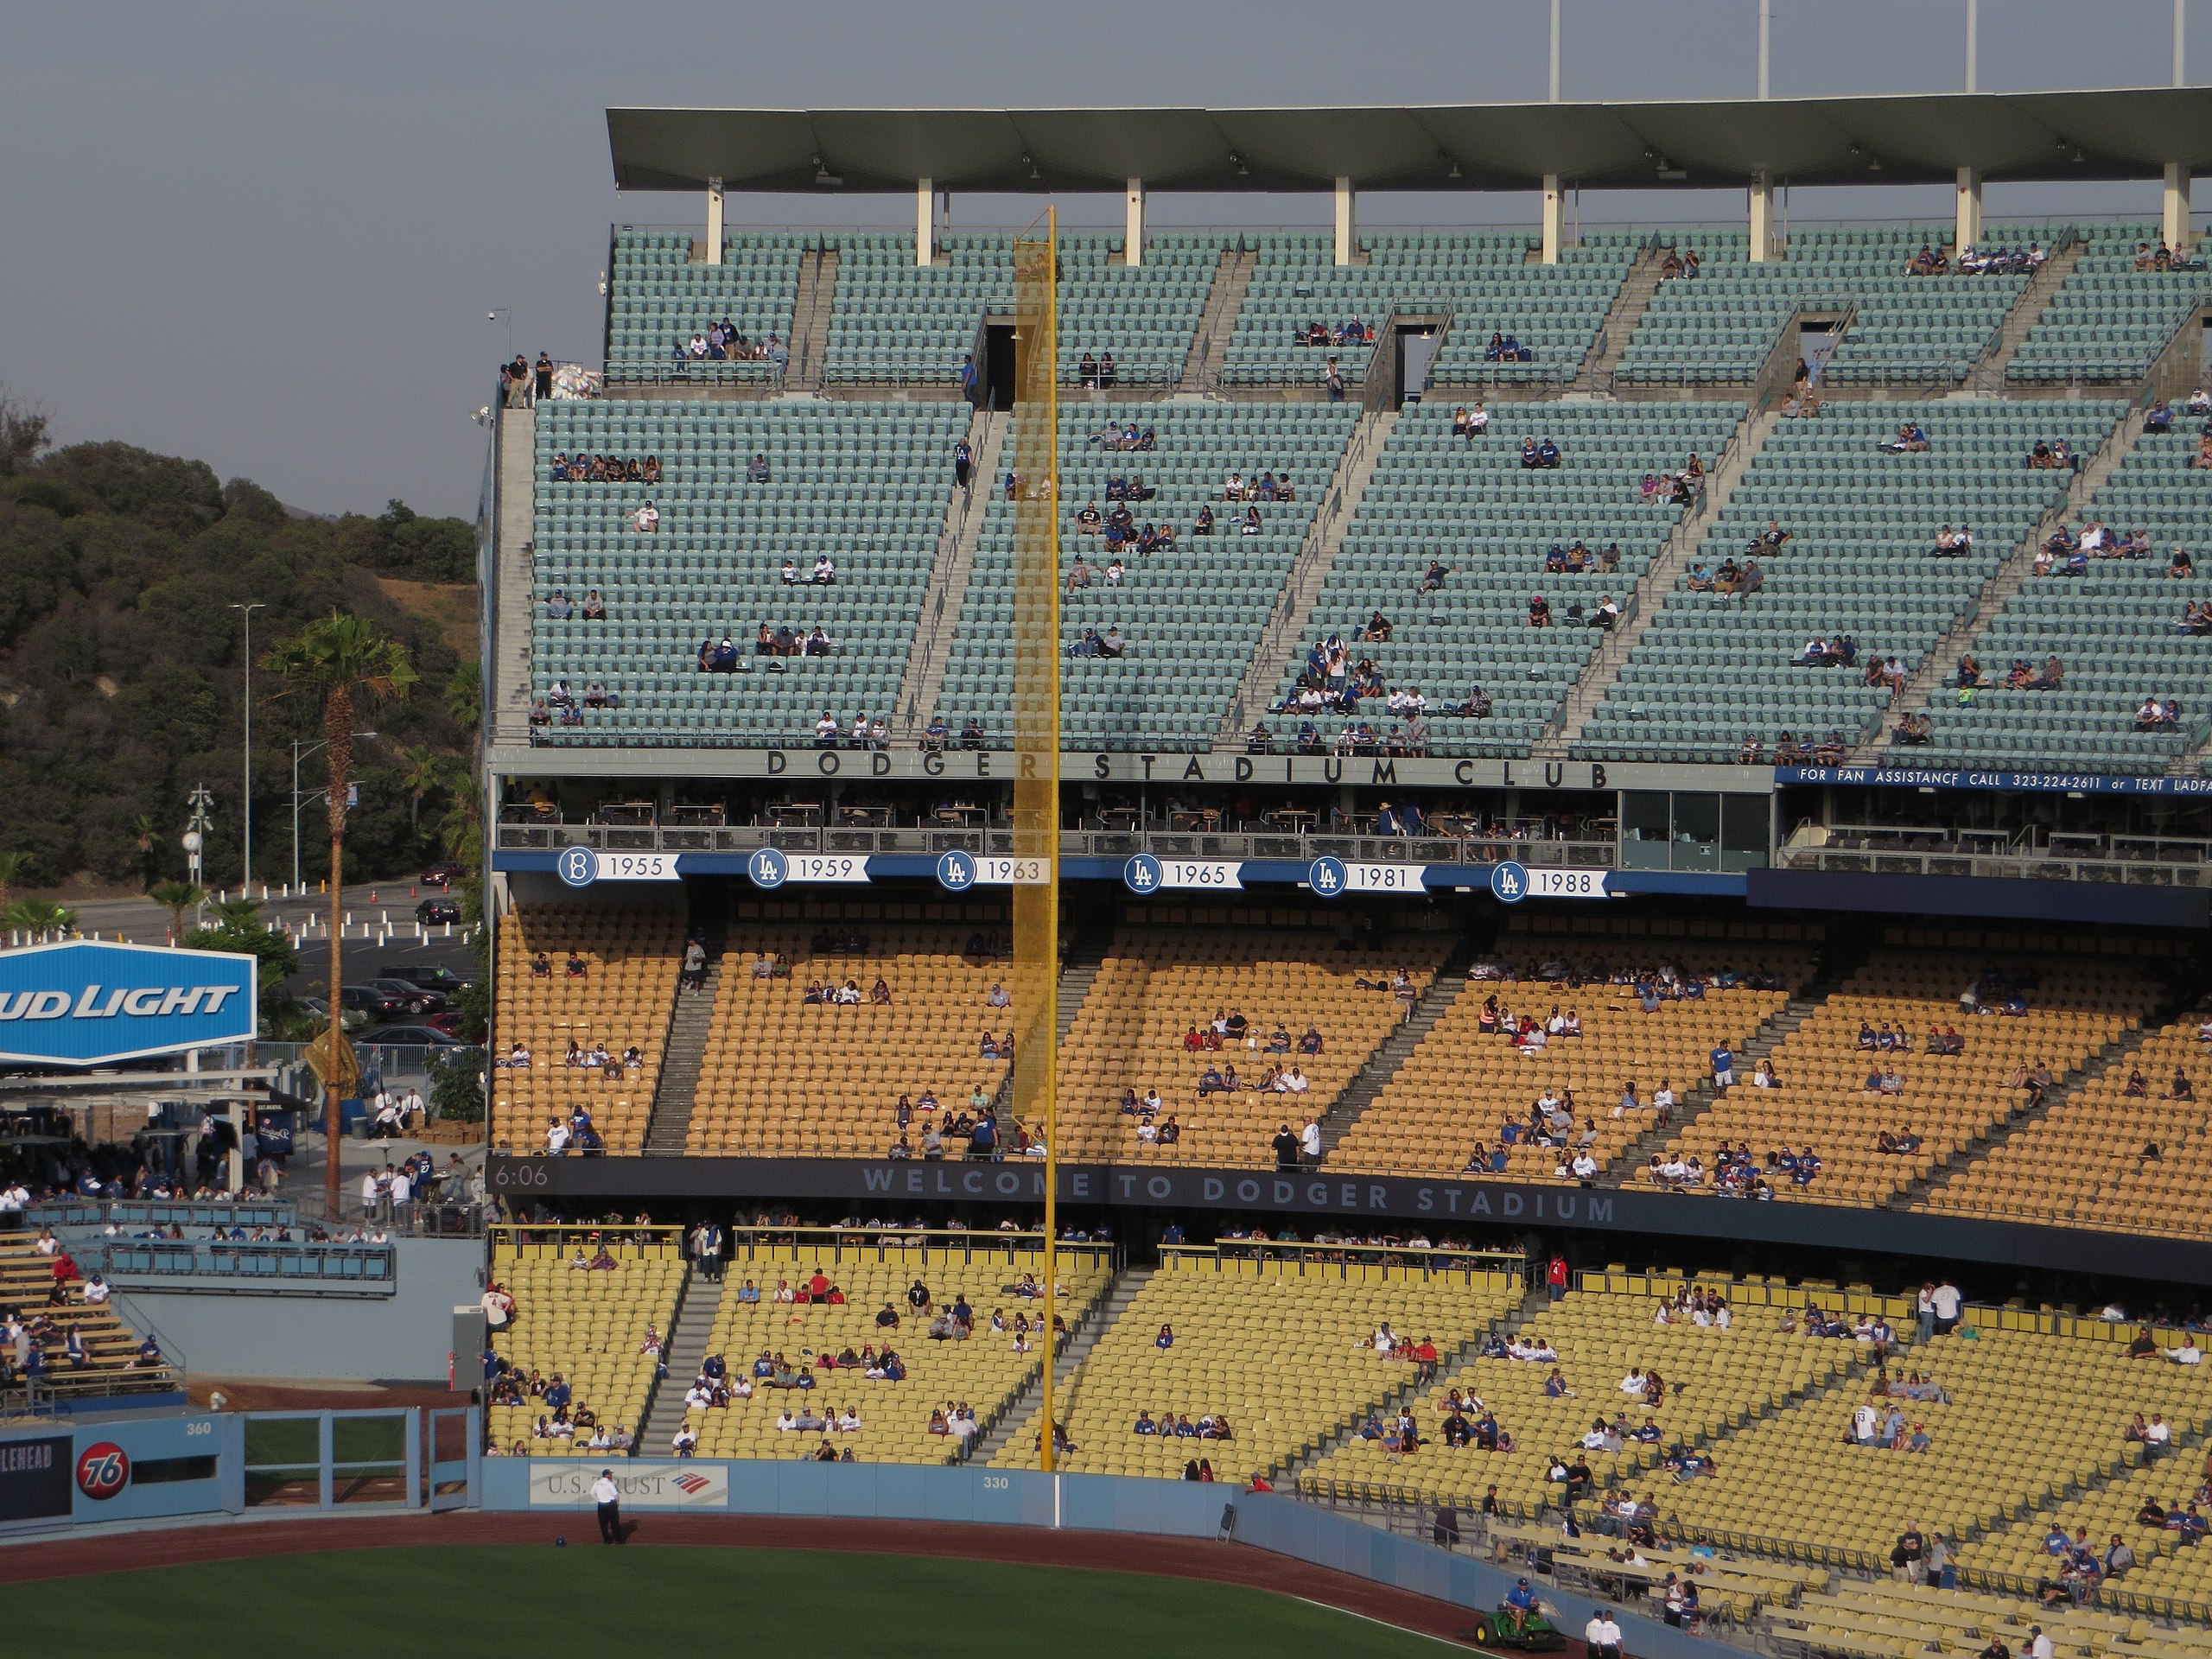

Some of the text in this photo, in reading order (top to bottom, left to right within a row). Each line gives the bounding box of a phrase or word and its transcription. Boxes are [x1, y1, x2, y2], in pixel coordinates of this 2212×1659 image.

[957, 446, 967, 461] LA
[766, 749, 1607, 789] DODGER STADIUM CLUB
[1800, 768, 1826, 781] FOR
[1837, 769, 1865, 782] FAN
[1969, 772, 2000, 786] CALL
[2012, 774, 2101, 790] 323-224-2611
[2111, 779, 2125, 789] or
[2135, 779, 2164, 791] TEXT
[611, 856, 664, 876] 1955
[760, 854, 778, 880] LA
[800, 858, 853, 879] 1959
[947, 856, 966, 882] LA
[988, 861, 1039, 880] 1963
[1134, 858, 1153, 887] LA
[1174, 864, 1226, 885] 1965
[1319, 861, 1338, 890] LA
[1359, 867, 1408, 887] 1981
[1501, 866, 1519, 895] LA
[1541, 873, 1591, 893] 1988
[72, 984, 240, 1018] LIGHT
[421, 1164, 430, 1173] 27
[496, 1165, 549, 1186] 6:06
[863, 1167, 1614, 1223] WELCOME TO DODGER STADIUM
[491, 1298, 498, 1307] 4
[186, 1421, 212, 1436] 360
[83, 1452, 124, 1487] 76
[548, 1476, 666, 1495] U.S. UST
[983, 1477, 1009, 1489] 330
